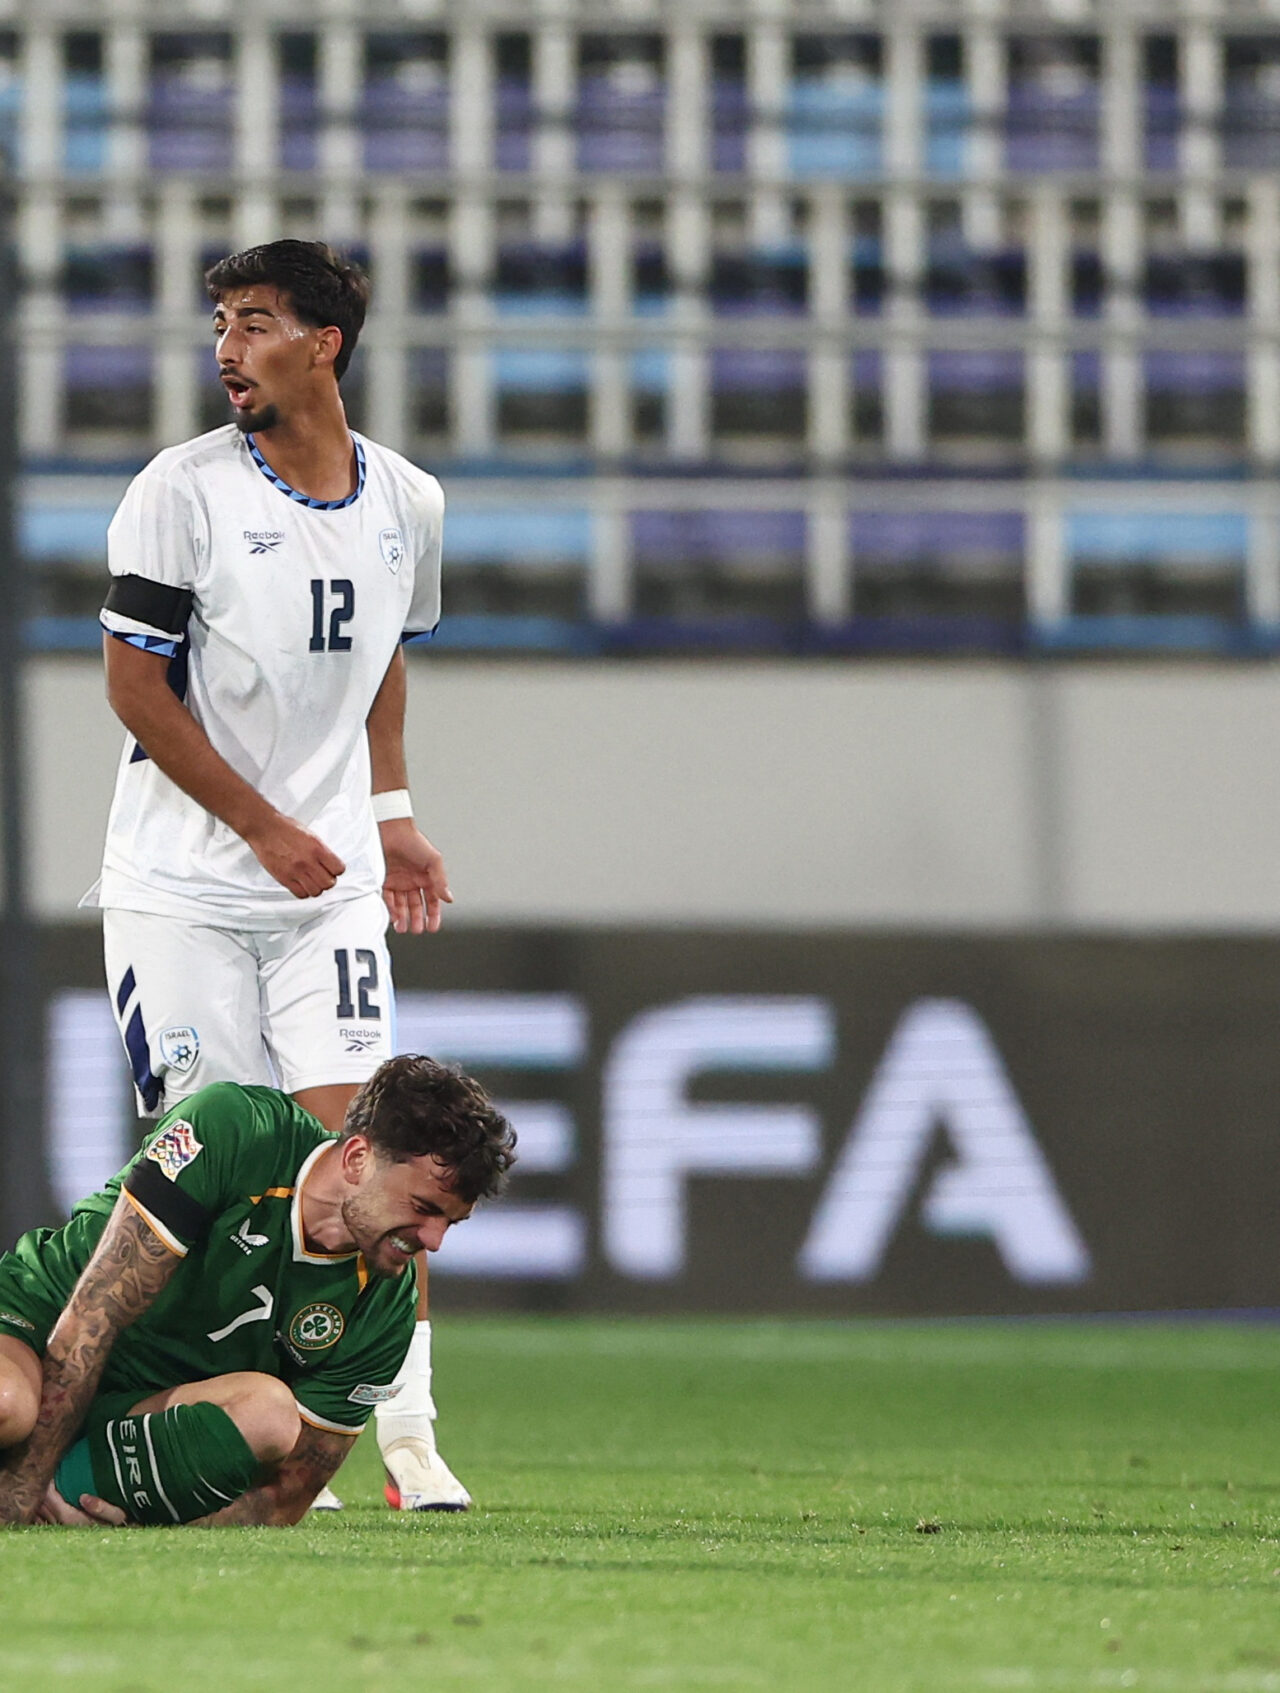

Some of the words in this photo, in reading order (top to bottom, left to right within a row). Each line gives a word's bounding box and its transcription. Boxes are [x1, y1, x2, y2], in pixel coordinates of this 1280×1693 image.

[243, 531, 286, 540] Reebok
[309, 579, 355, 653] 12
[334, 948, 381, 1020] 12
[164, 1030, 191, 1040] ISRAEL
[339, 1028, 381, 1039] Reebok
[206, 1284, 273, 1342] 7
